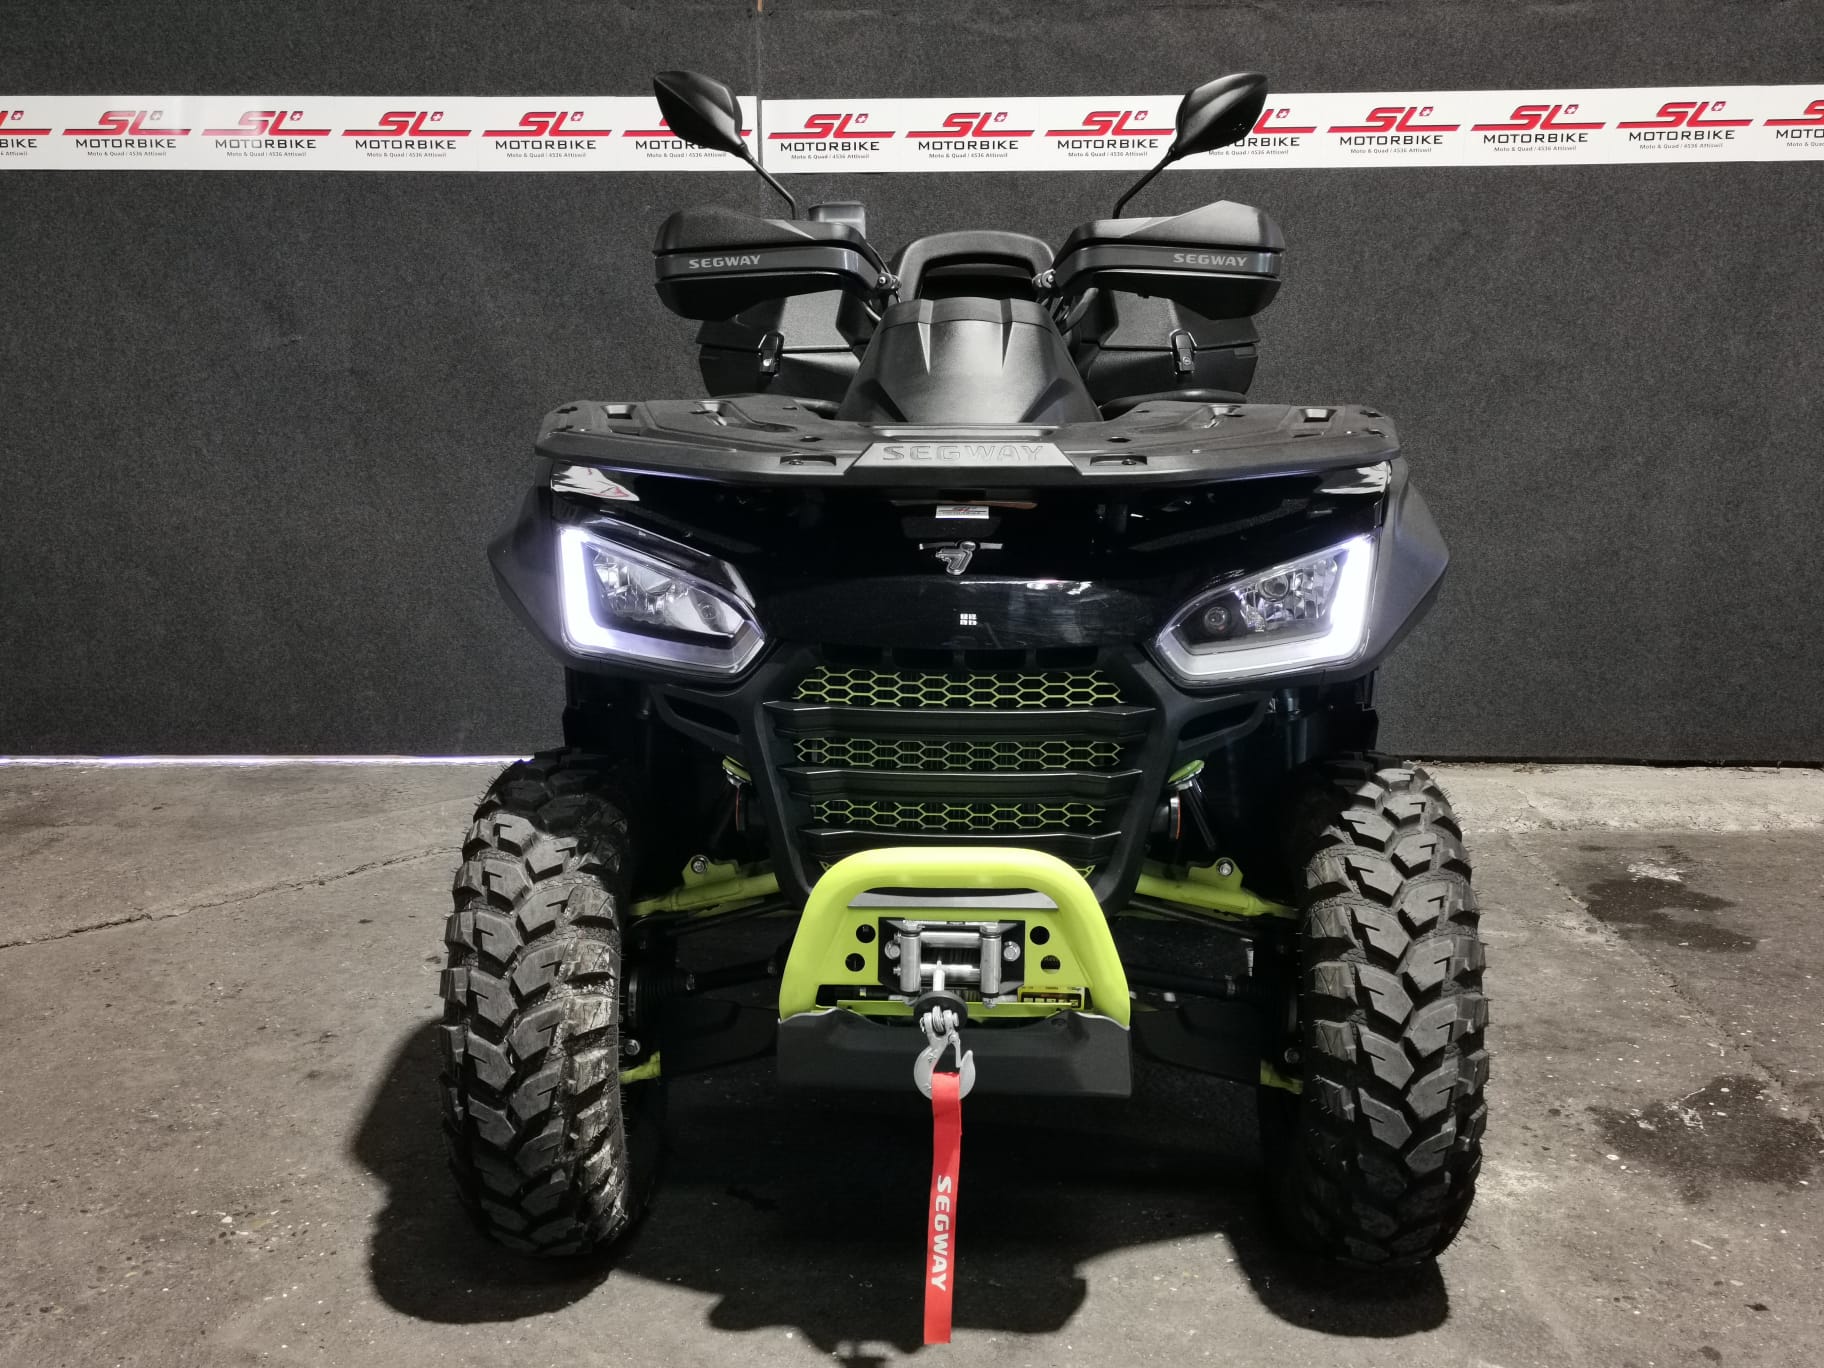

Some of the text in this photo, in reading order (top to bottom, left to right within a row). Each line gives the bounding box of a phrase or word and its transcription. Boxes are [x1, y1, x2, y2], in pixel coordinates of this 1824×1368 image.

[1340, 135, 1444, 146] MOTORBIKE
[1483, 133, 1588, 144] MOTORBIKE
[1628, 130, 1736, 141] MOTORBIKE
[76, 138, 177, 148] MOTORBIKE
[215, 139, 317, 149] MOTORBIKE
[355, 140, 456, 149] MOTORBIKE
[495, 140, 596, 150] MOTORBIKE
[635, 140, 706, 149] MOTOR
[780, 142, 880, 151] MOTORBIKE
[918, 140, 1019, 150] MOTORBIKE
[1057, 139, 1159, 149] MOTORBIKE
[1234, 137, 1300, 147] ORBIKE
[688, 254, 761, 269] SEGWAY
[1173, 253, 1248, 267] SEGWAY
[882, 445, 1044, 461] SEGWAY
[931, 1174, 952, 1291] SEGWAY
